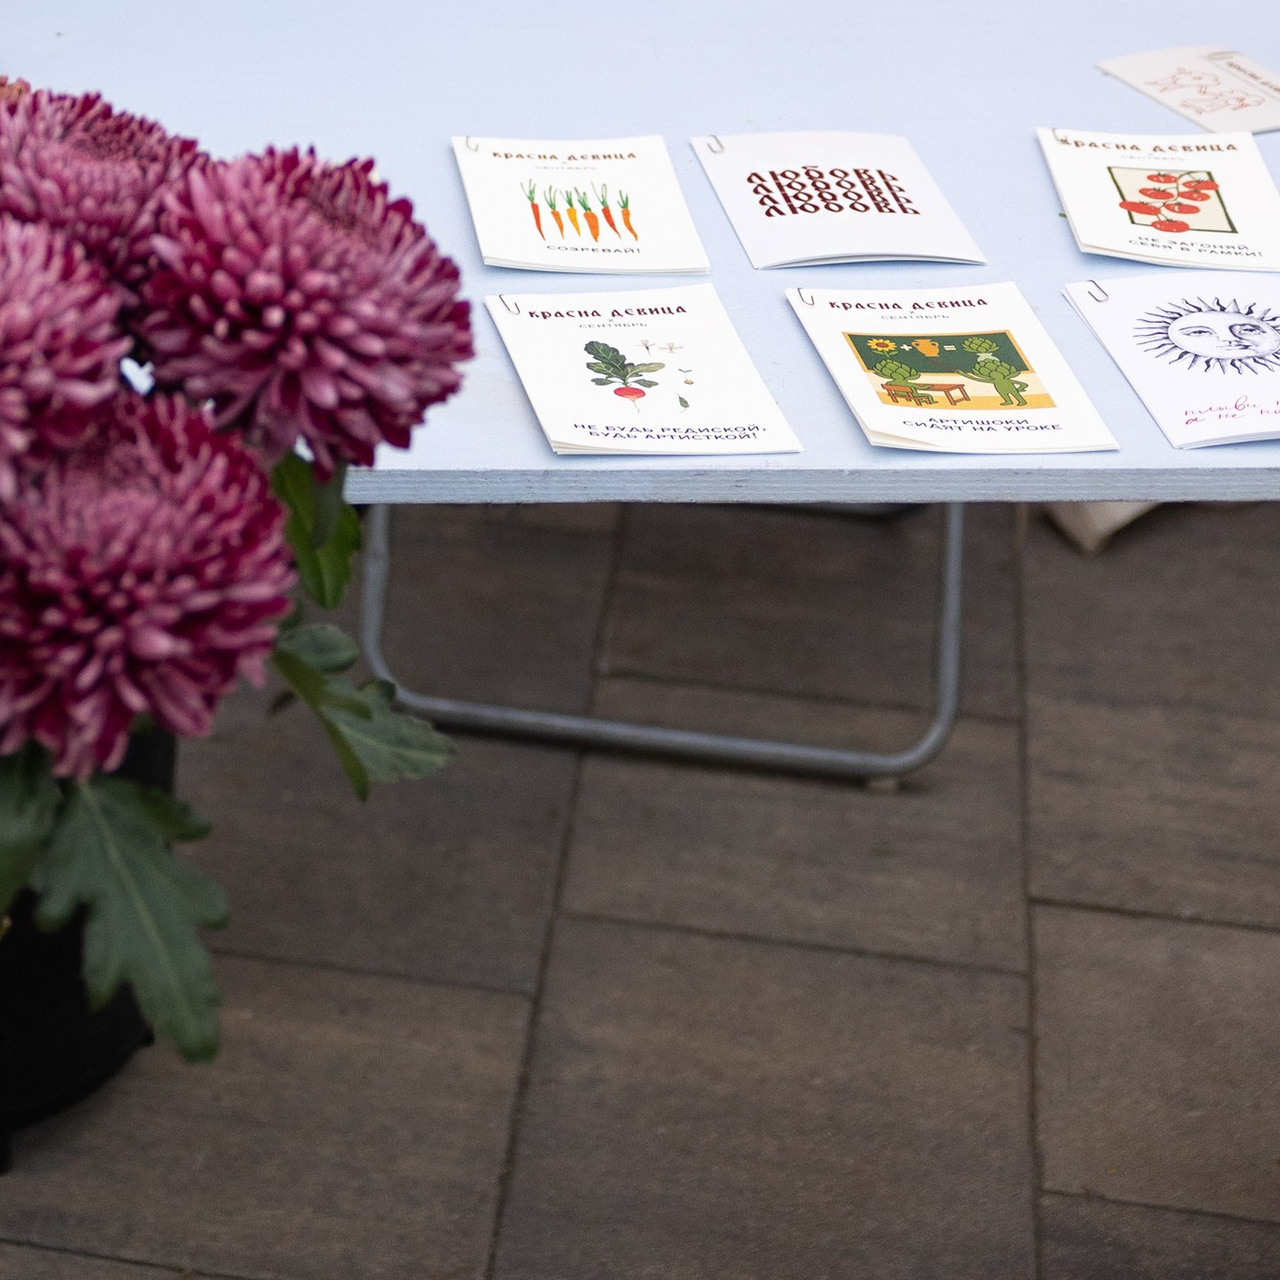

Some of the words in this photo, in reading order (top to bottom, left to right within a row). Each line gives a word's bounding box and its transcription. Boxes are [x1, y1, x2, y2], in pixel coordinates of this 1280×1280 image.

[546, 244, 641, 254] СОЗРЕВАЙ!
[902, 420, 964, 431] СИДЯТ
[928, 417, 1030, 425] АРТИШОКИ
[605, 425, 654, 433] БУДЬ
[660, 424, 767, 434] РЕДИСКОЙ,
[589, 431, 638, 439] БУДЬ
[645, 432, 758, 441] АРТИСТКОЙ!
